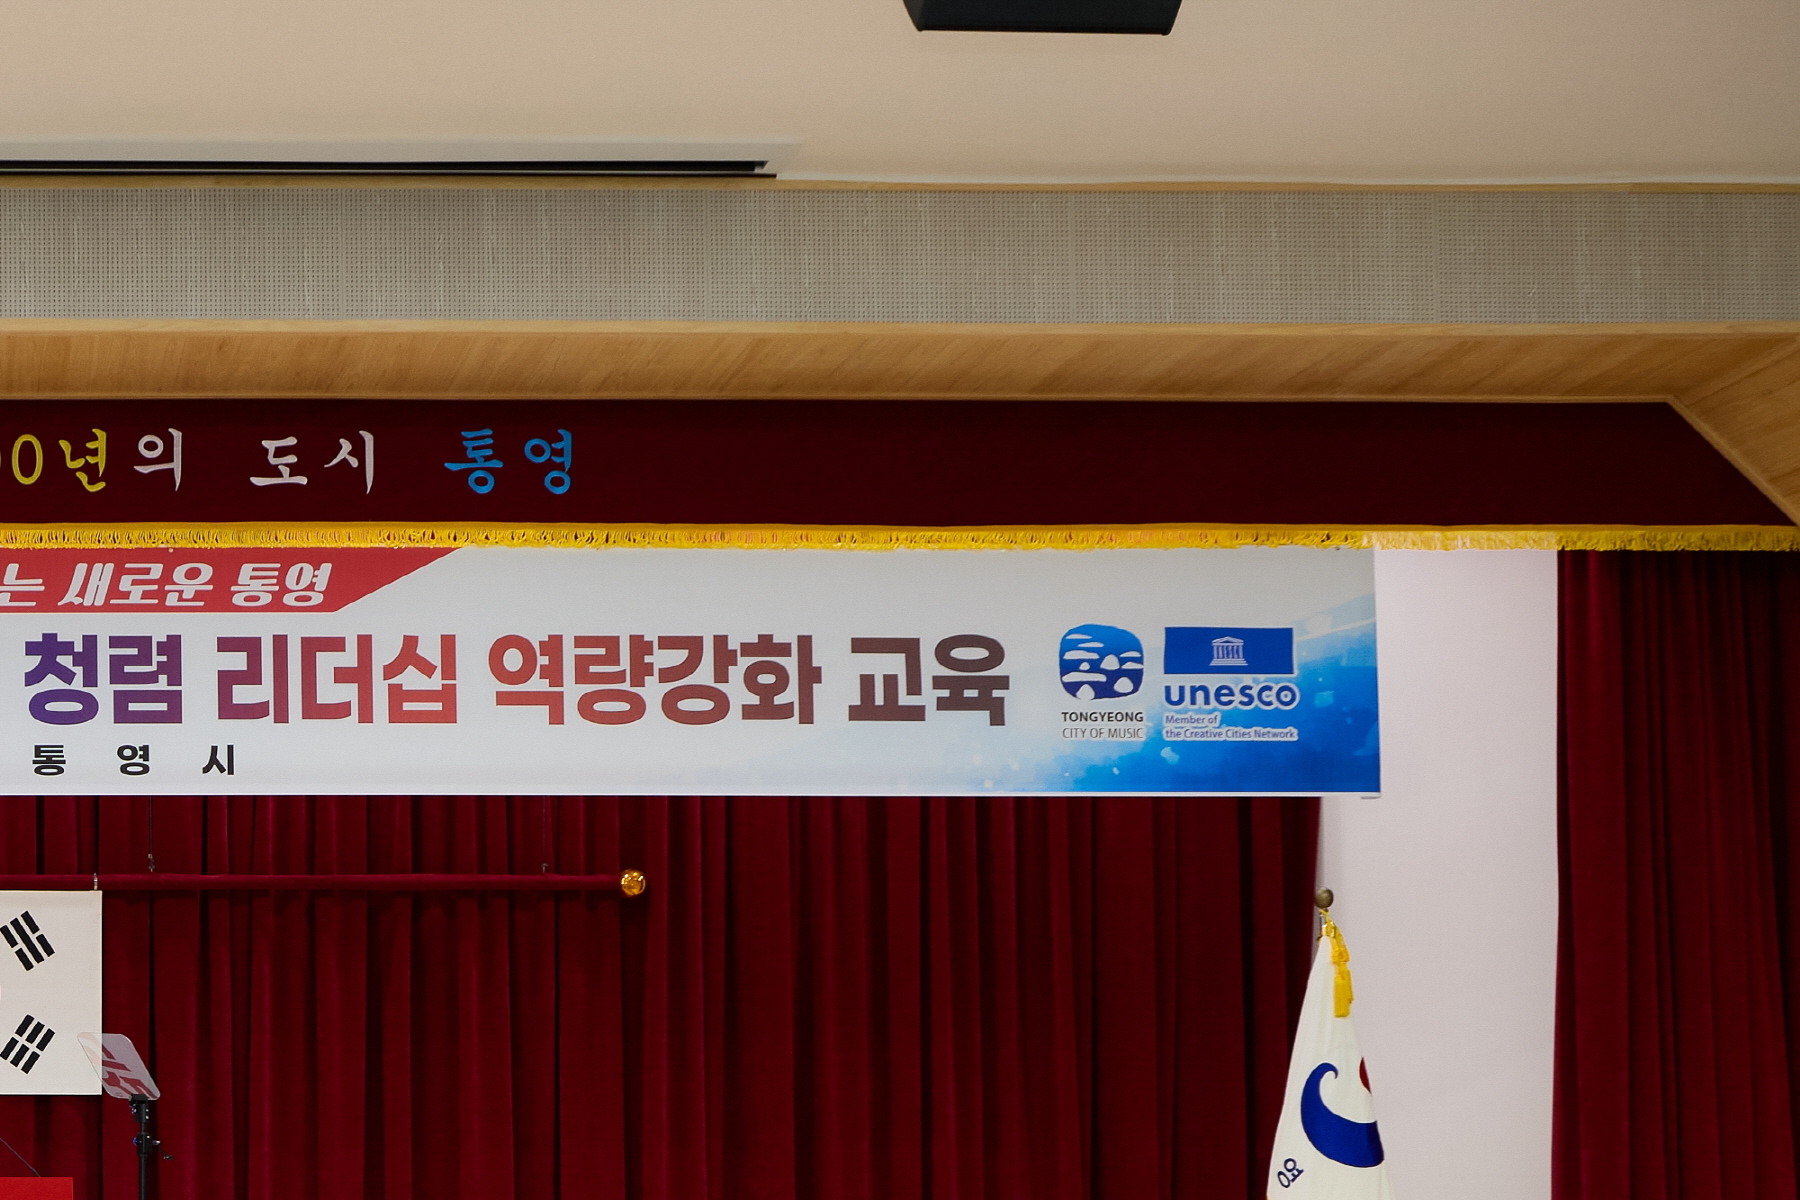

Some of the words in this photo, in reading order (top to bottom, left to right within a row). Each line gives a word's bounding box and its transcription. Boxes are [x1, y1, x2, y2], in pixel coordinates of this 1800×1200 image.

[249, 430, 374, 495] 도시
[444, 428, 573, 495] 통영
[57, 562, 214, 607] 새로운
[230, 562, 333, 607] 통영
[24, 632, 183, 726] 청렴
[216, 634, 458, 724] 리더십
[488, 633, 823, 726] 역량강화
[848, 634, 1011, 727] 교육
[1163, 683, 1298, 708] unesco
[1061, 711, 1144, 723] TONGYEONG
[1165, 714, 1206, 725] Member
[1207, 714, 1219, 725] of
[1062, 727, 1088, 739] CITY
[1089, 727, 1105, 739] OF
[1107, 727, 1144, 739] MUSIC
[1165, 728, 1182, 739] the
[1183, 728, 1224, 739] Creative
[1225, 728, 1252, 739] Cities
[1254, 728, 1296, 739] Network
